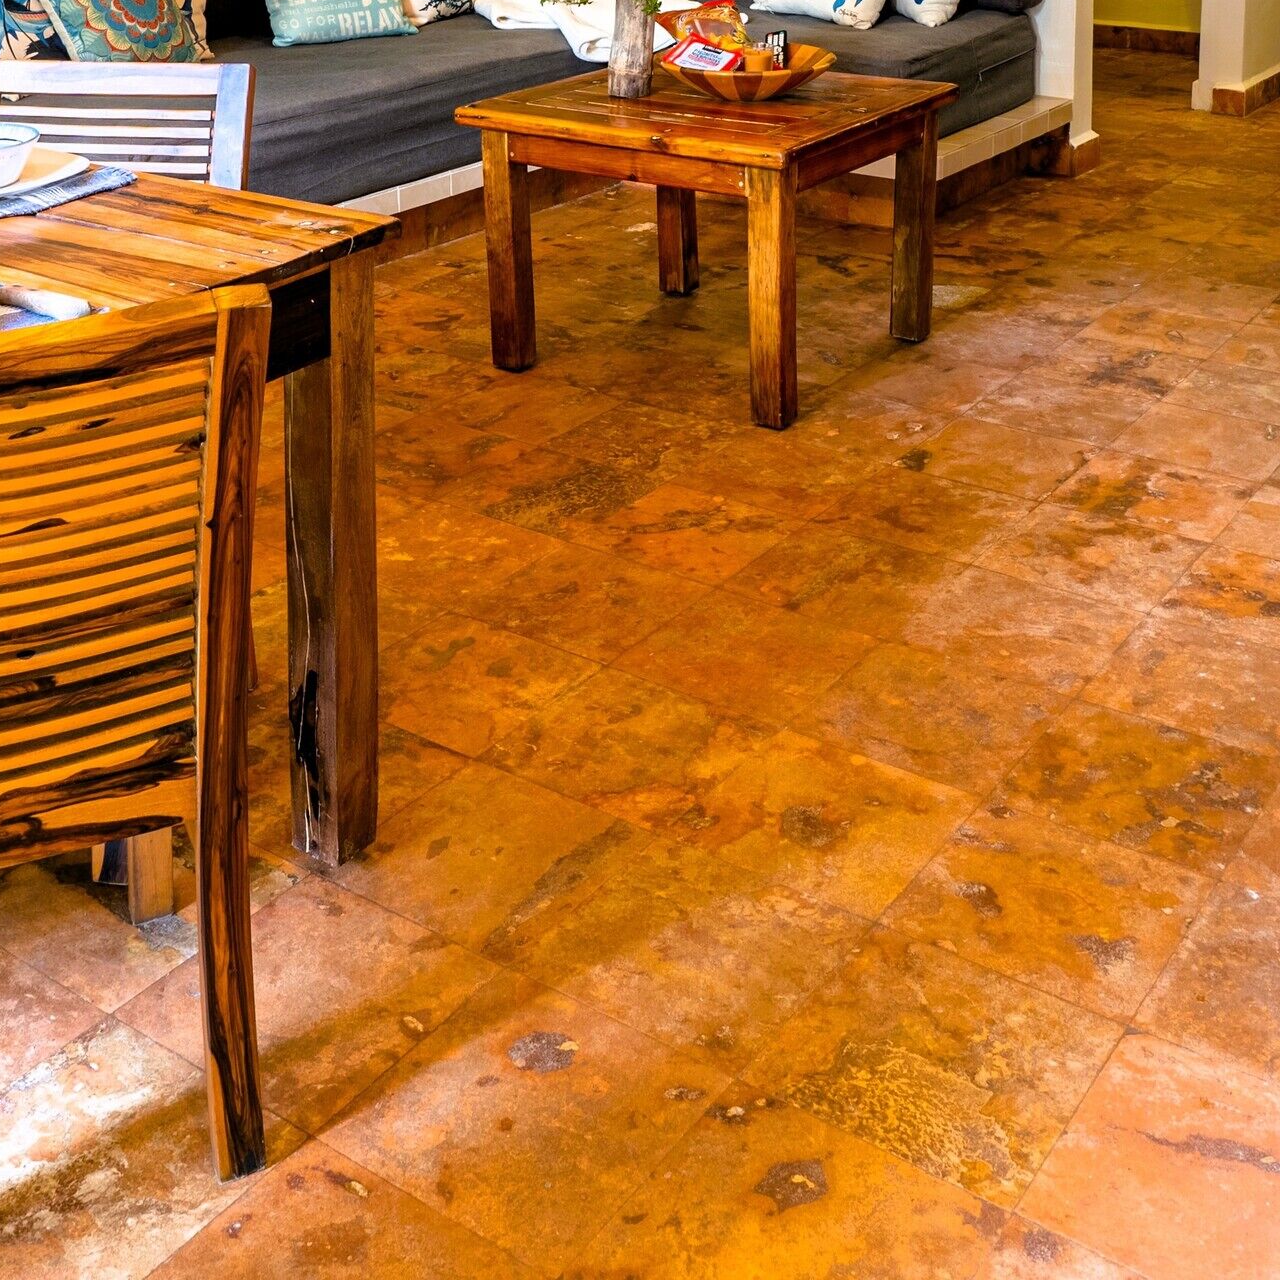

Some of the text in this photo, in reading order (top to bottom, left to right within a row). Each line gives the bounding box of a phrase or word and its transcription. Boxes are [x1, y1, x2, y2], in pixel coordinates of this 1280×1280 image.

[278, 14, 336, 30] GO FOR
[338, 6, 405, 36] RELAX
[299, 29, 338, 41] WALK
